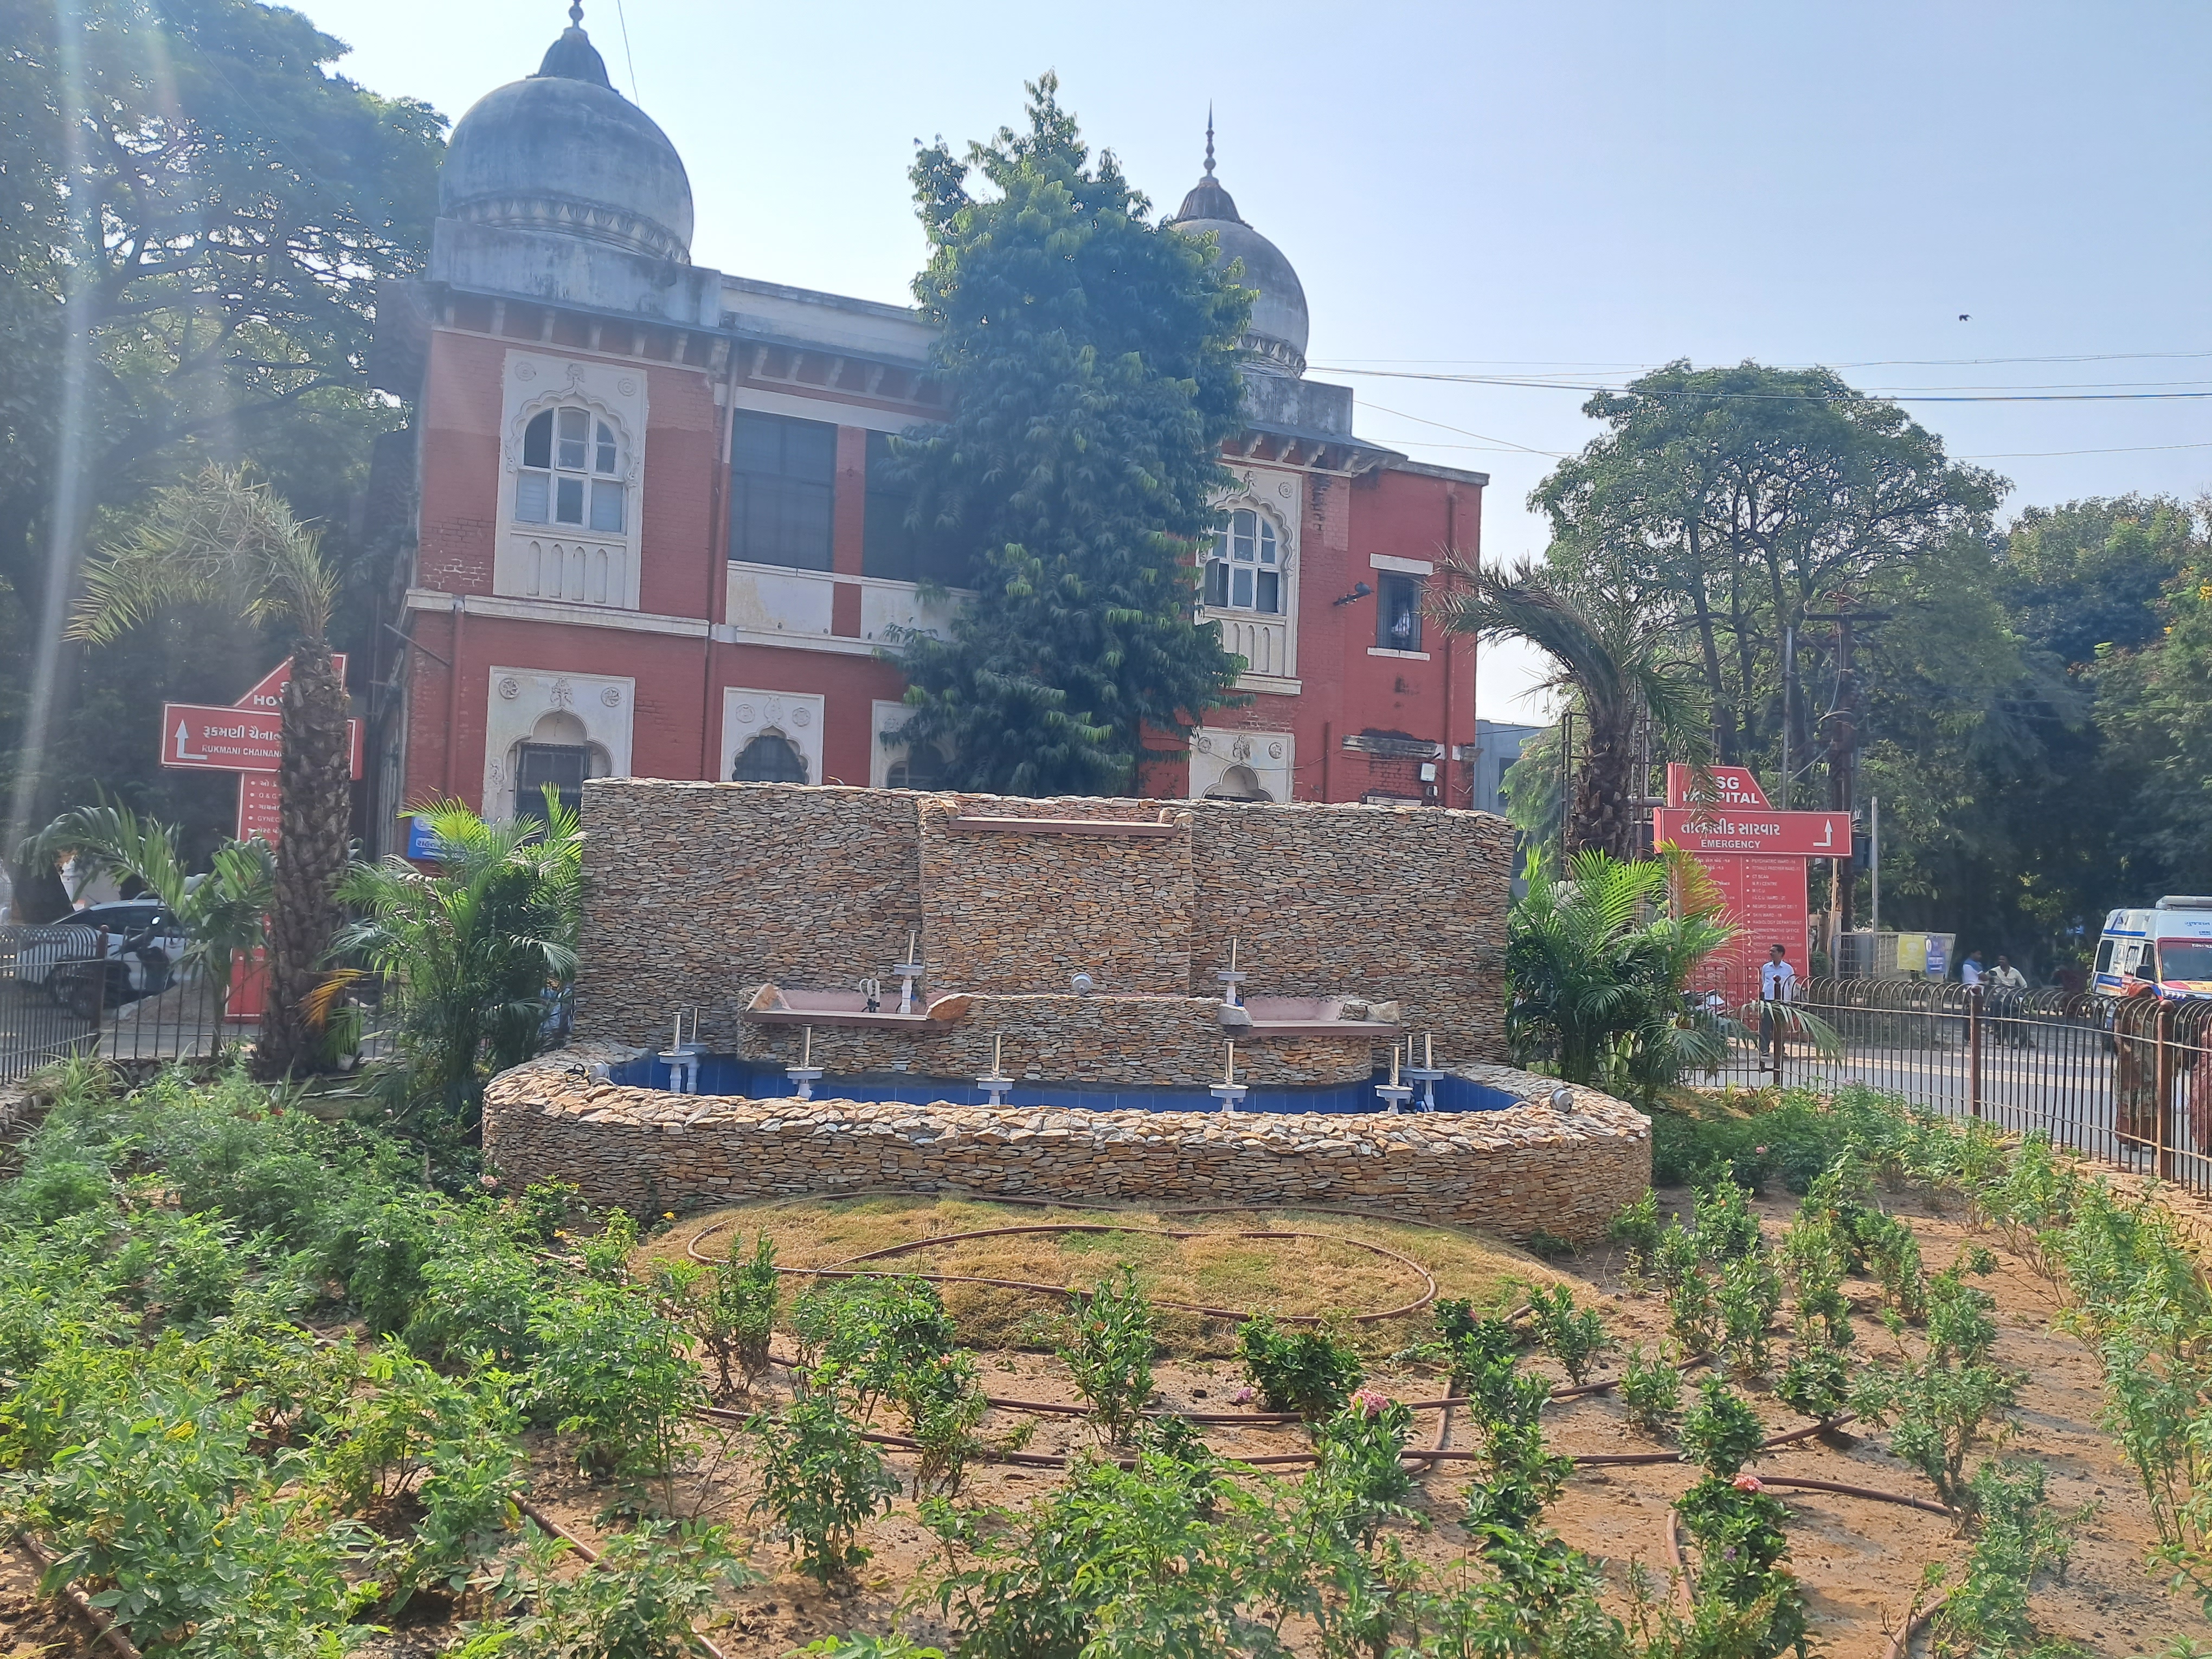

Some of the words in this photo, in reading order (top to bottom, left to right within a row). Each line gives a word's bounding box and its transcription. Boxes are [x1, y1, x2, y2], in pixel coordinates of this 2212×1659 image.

[203, 725, 245, 738] રૂકમણી
[202, 745, 241, 755] RUKMANI
[1712, 776, 1740, 790] SG
[1682, 790, 1759, 804] HPITAL
[1738, 822, 1780, 835] સારવાર
[1701, 839, 1761, 848] EMERGENCY
